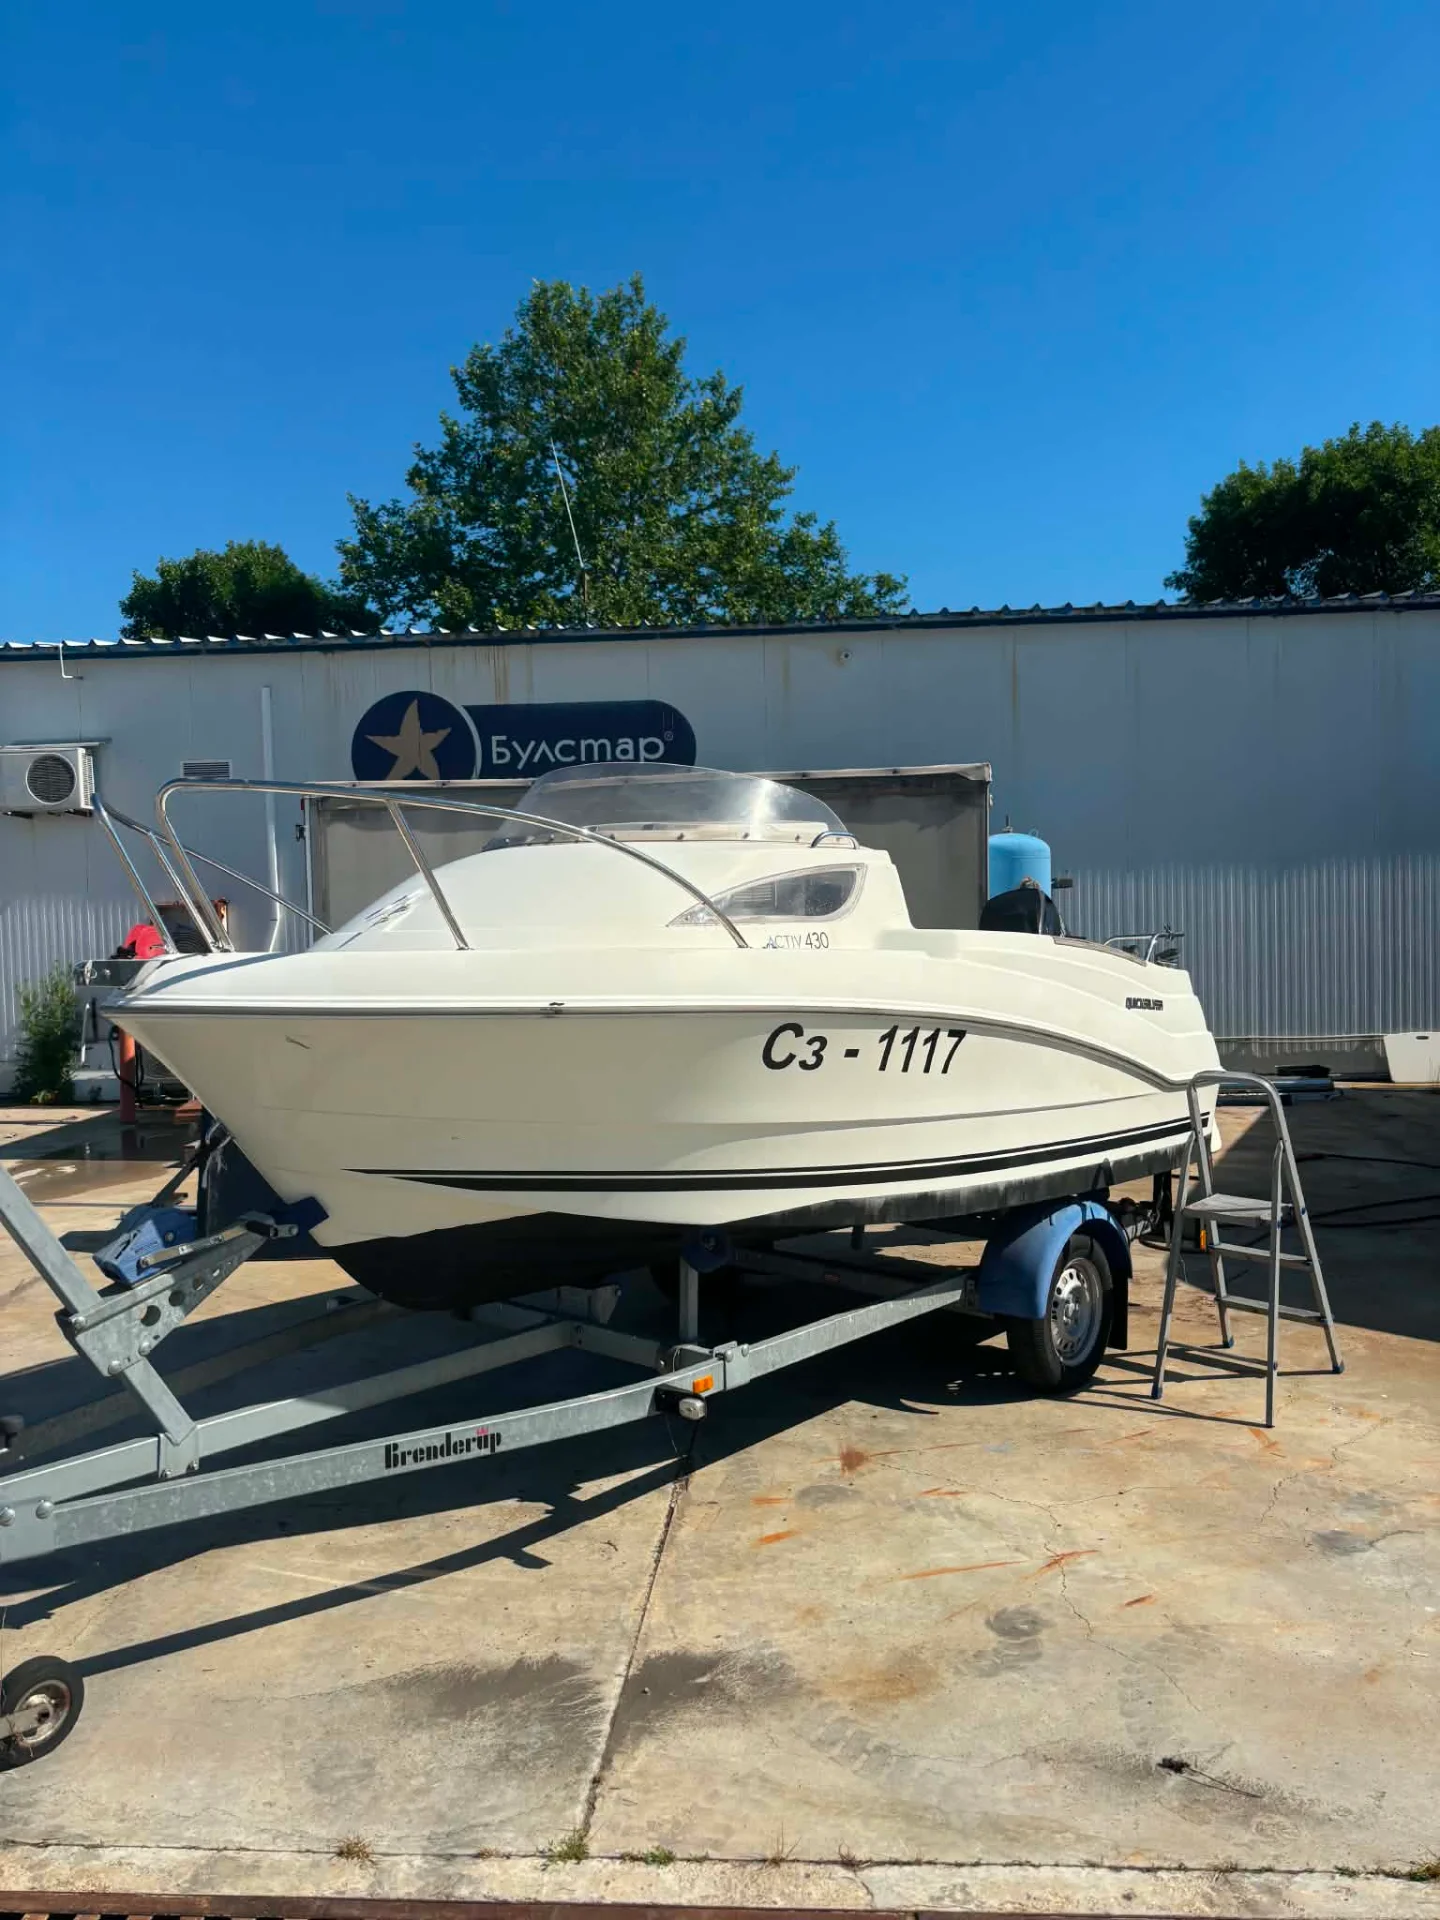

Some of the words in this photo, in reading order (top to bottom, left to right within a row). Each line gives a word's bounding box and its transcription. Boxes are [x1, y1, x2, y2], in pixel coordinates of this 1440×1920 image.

[491, 735, 665, 770] Булстар
[805, 931, 829, 949] 430
[878, 1024, 967, 1075] 1117
[384, 1432, 502, 1470] Brenderup
